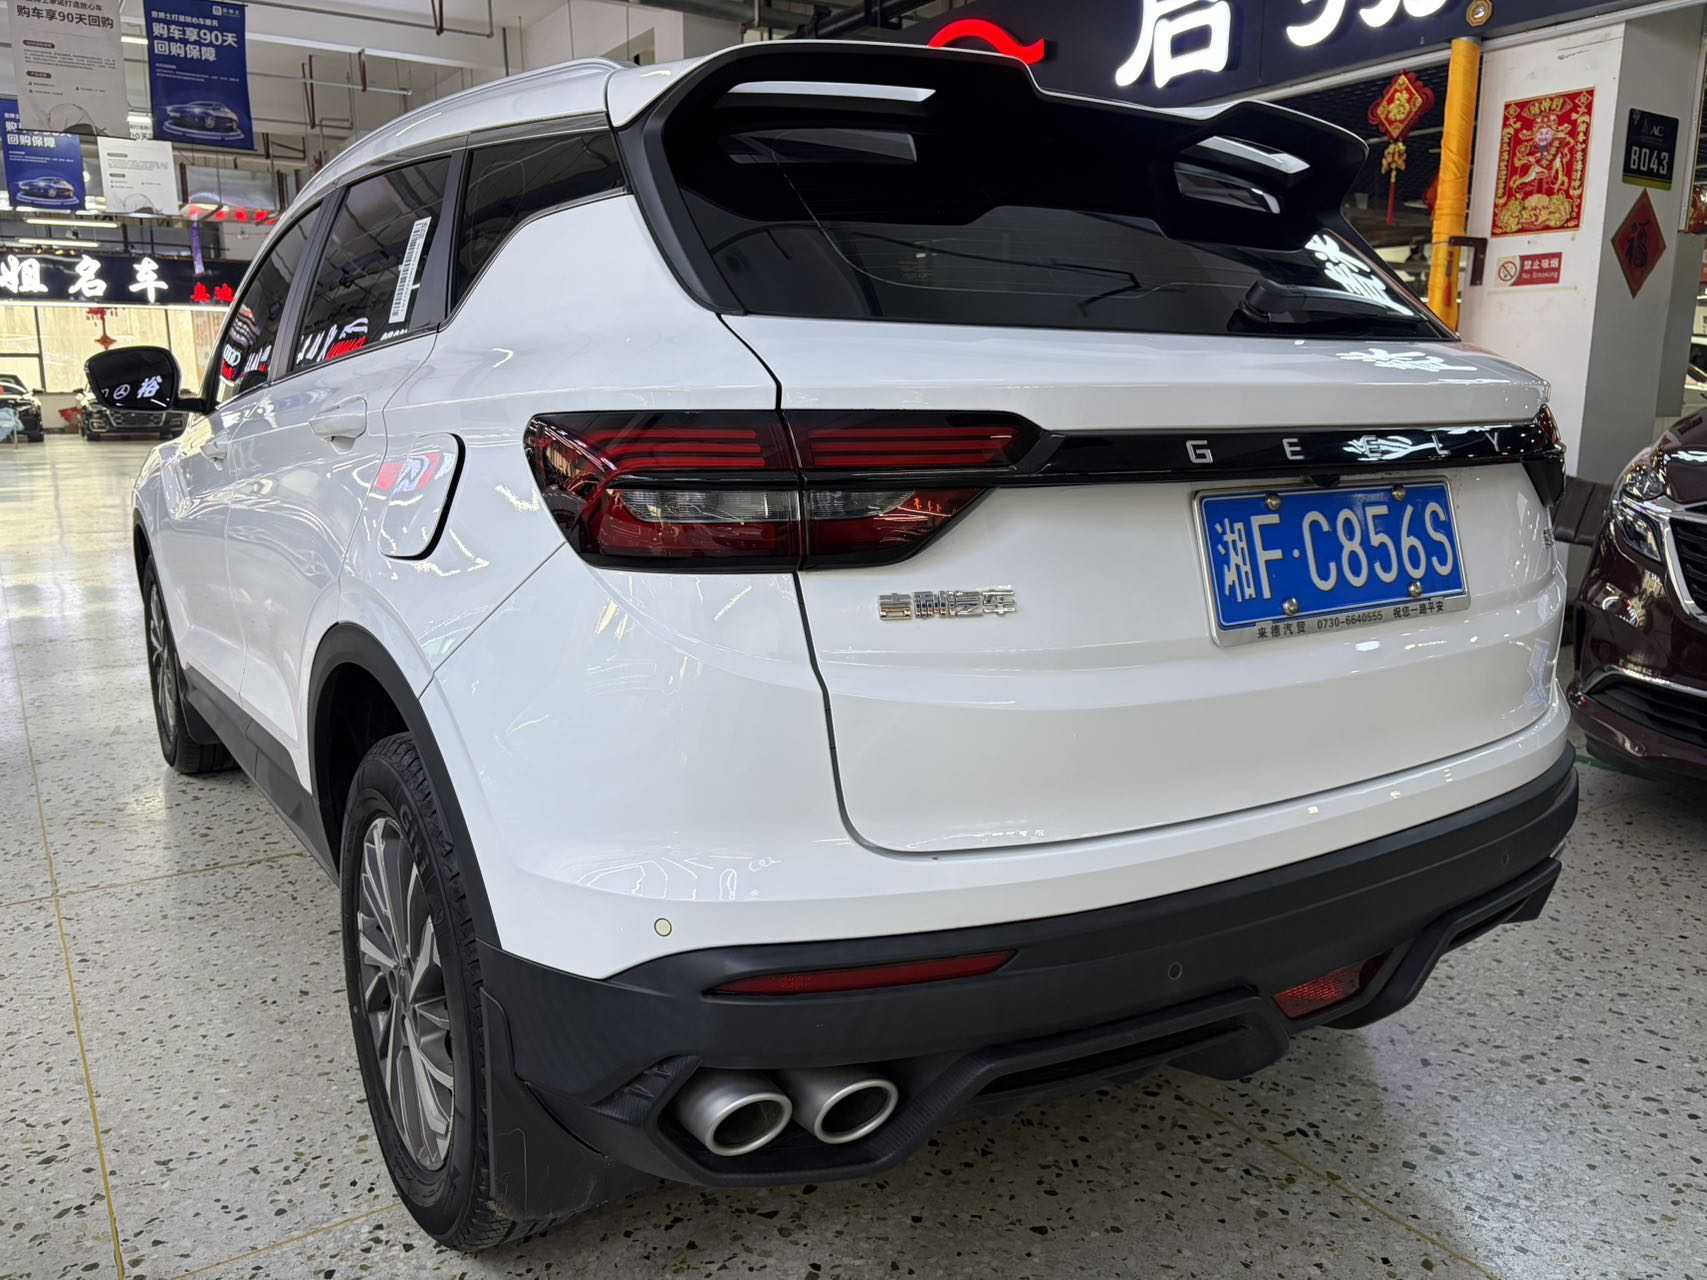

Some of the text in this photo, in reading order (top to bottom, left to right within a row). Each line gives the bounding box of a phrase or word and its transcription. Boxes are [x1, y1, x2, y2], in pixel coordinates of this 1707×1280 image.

[16, 4, 114, 29] 购车享90天回购
[152, 22, 238, 48] 购车享90天
[154, 40, 217, 62] 回购保障
[1185, 432, 1502, 464] GEELY
